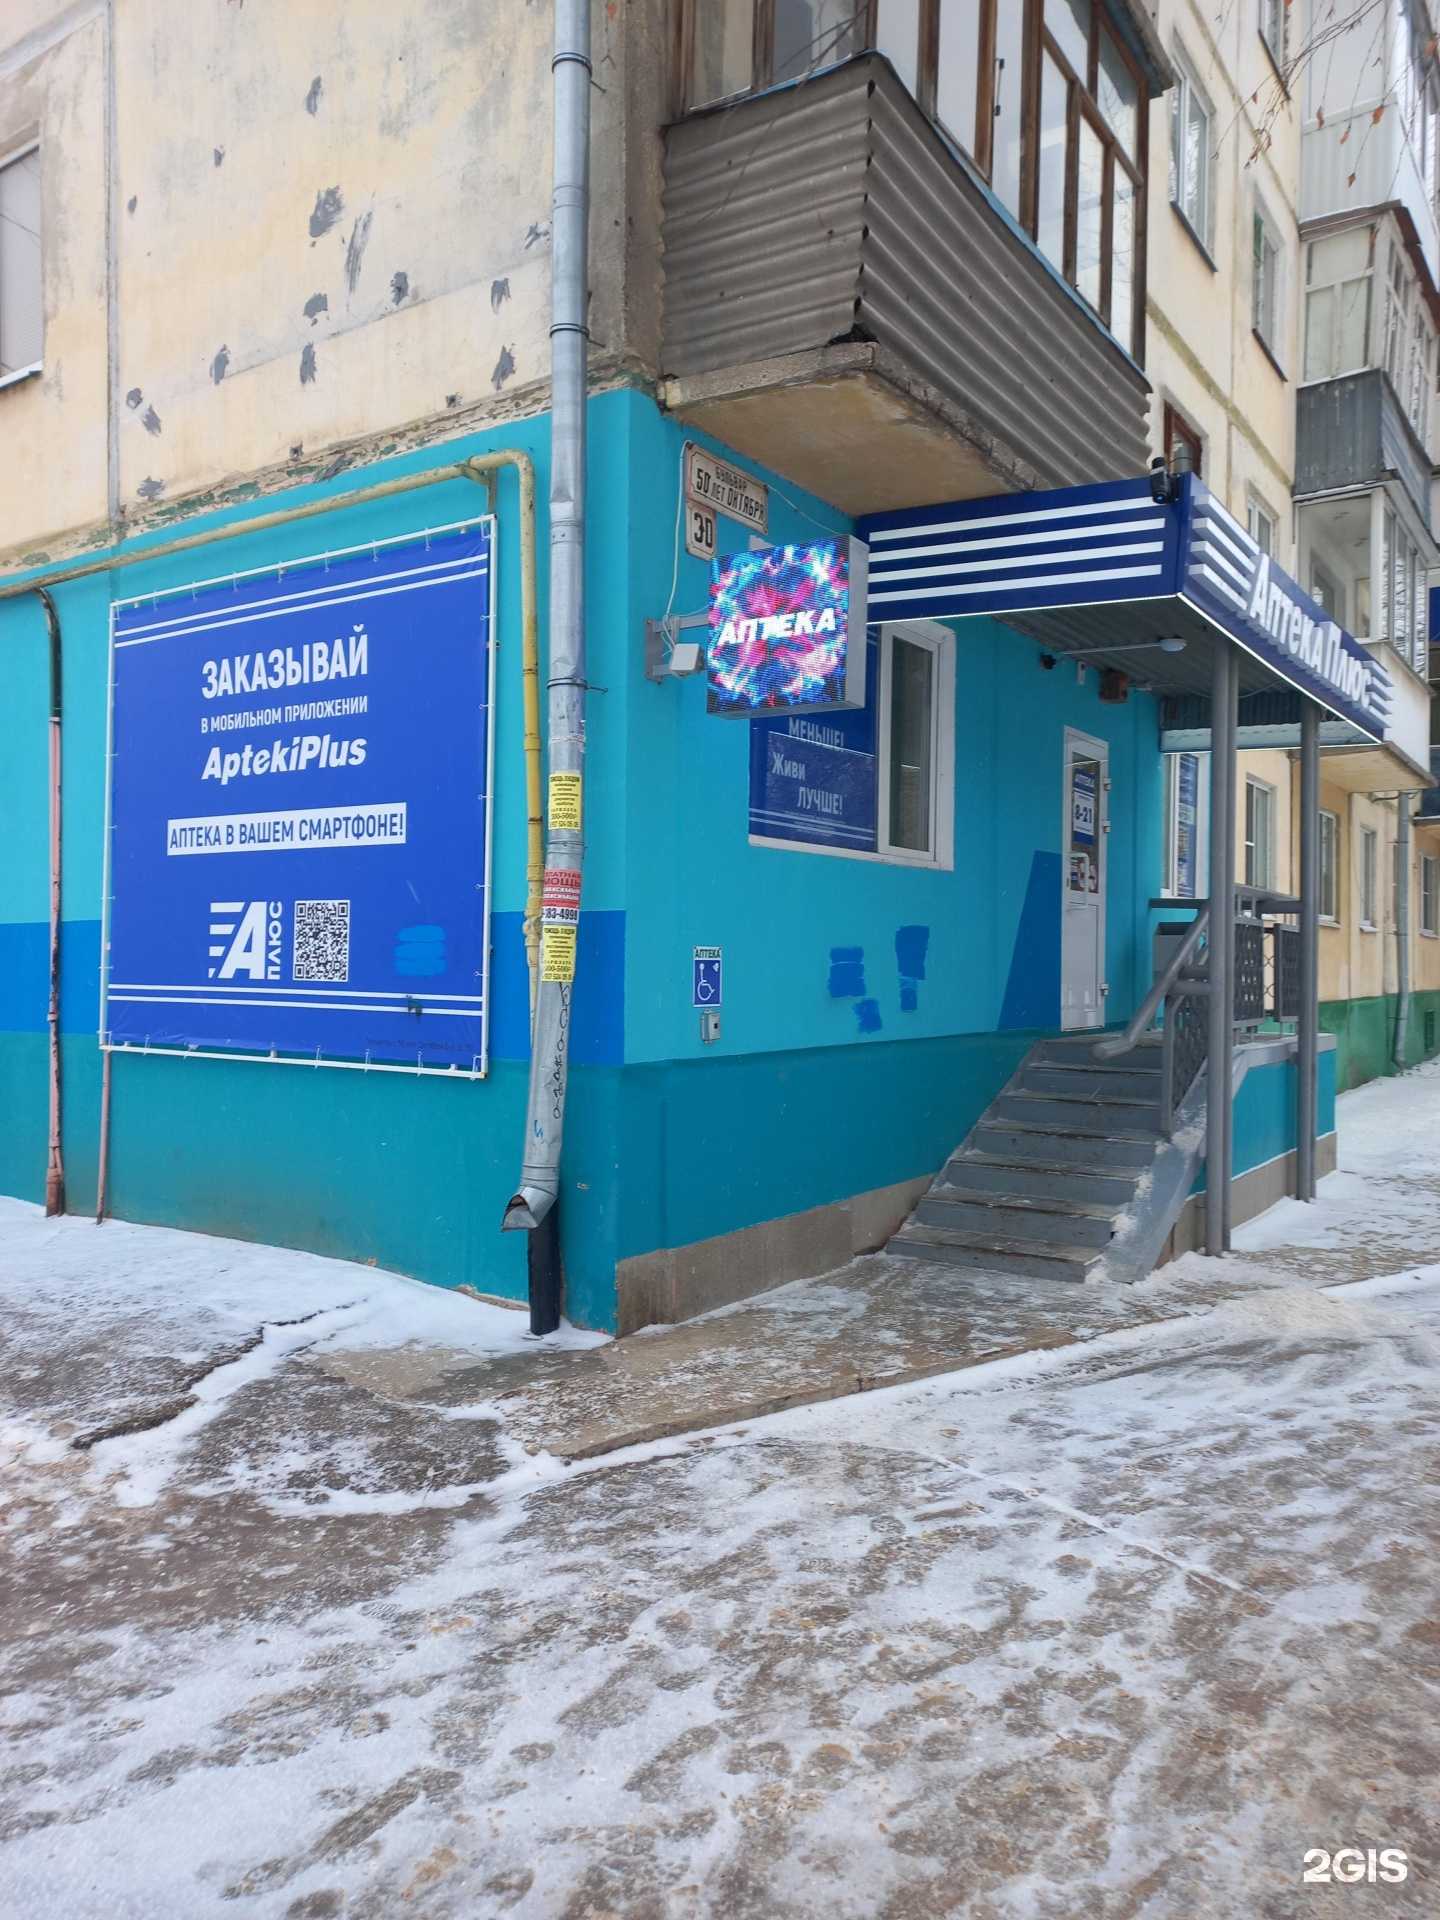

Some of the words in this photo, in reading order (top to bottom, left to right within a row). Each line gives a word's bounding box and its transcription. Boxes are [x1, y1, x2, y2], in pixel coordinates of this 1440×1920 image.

[696, 468, 711, 493] 50
[711, 482, 726, 501] ЛЕТ
[727, 487, 765, 521] ОКТЯБРЯ
[694, 512, 713, 548] 30
[716, 607, 837, 647] АПТЕКА
[201, 623, 368, 699] ЗАКАЗЫВАЙ
[200, 717, 209, 734] В
[210, 707, 281, 733] МОБИЛЬНОМ
[284, 695, 368, 723] ПРИЛОЖЕНИИ
[788, 716, 845, 751] МЕНЬШЕ!
[201, 734, 368, 786] AptekiPlus
[771, 752, 806, 781] Живи
[797, 786, 844, 816] ЛУЧШЕ!
[169, 825, 222, 849] АПТЕКА
[226, 824, 234, 845] В
[239, 819, 295, 845] ВАШЕМ
[298, 812, 404, 842] СМАРТФОНЕ!
[267, 901, 283, 980] ПЛЮС
